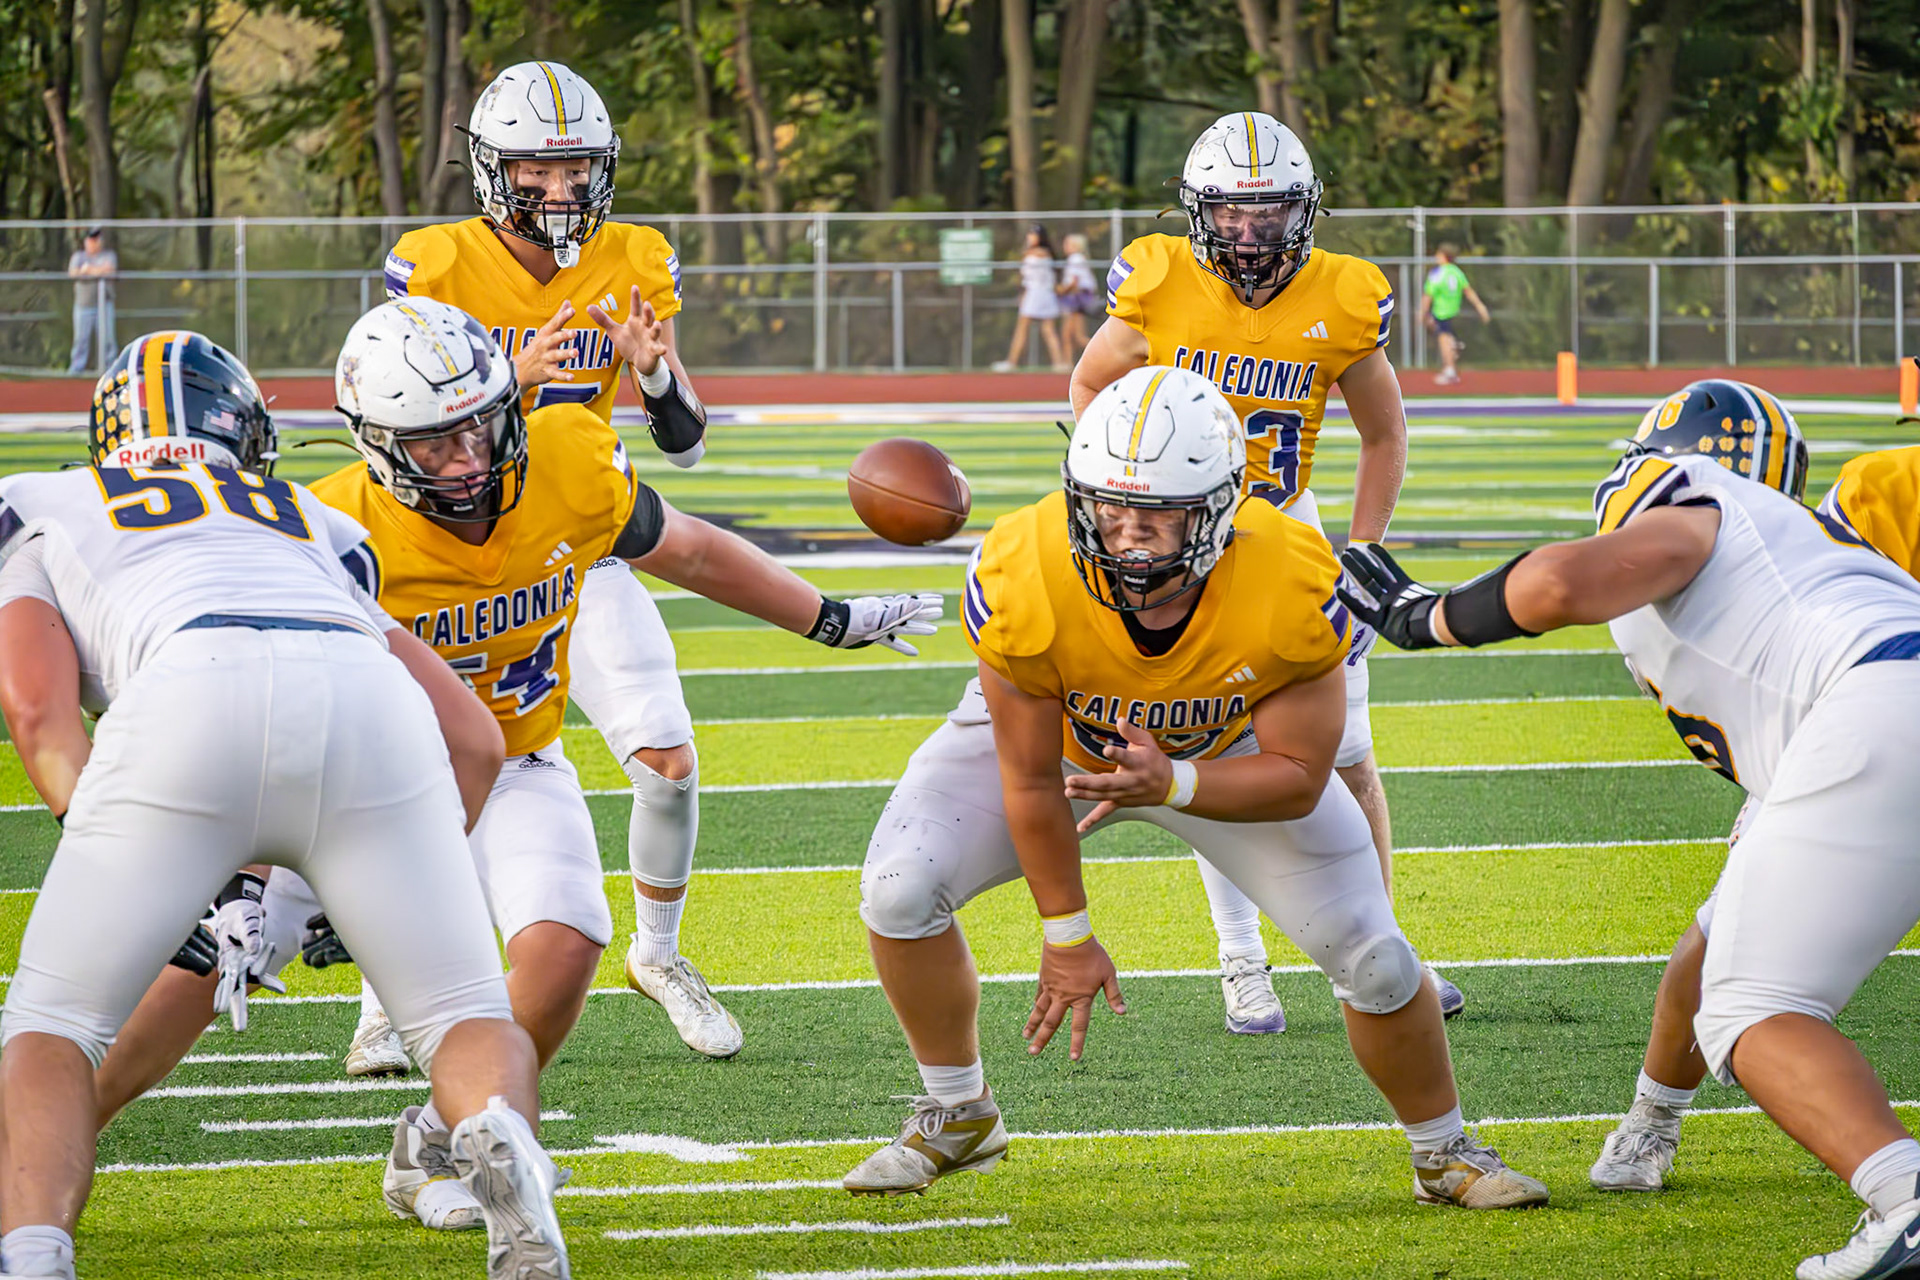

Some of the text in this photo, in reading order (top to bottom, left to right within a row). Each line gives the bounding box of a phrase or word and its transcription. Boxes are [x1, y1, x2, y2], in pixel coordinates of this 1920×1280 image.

[546, 137, 582, 147] Riddell
[1237, 178, 1273, 188] Riddell
[119, 443, 205, 467] Riddell
[1106, 477, 1150, 492] Riddell
[89, 461, 315, 542] 58
[1066, 689, 1246, 730] CALEDONIA
